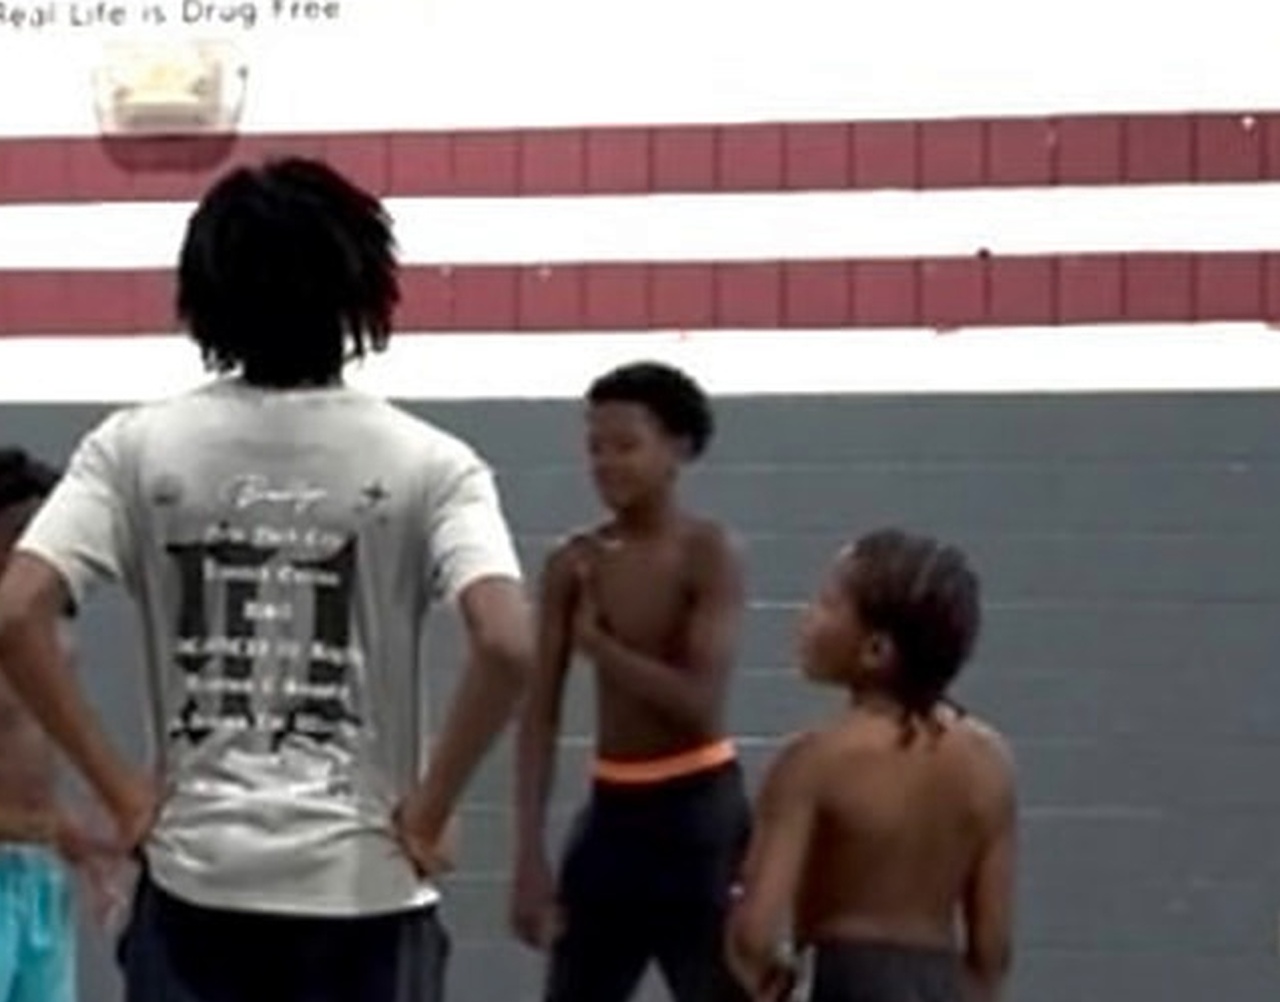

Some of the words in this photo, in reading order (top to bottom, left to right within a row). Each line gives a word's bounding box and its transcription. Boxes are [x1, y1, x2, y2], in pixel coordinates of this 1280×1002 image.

[70, 0, 127, 27] Life
[141, 2, 168, 26] is
[181, 0, 257, 30] Drug
[272, 0, 341, 20] Free
